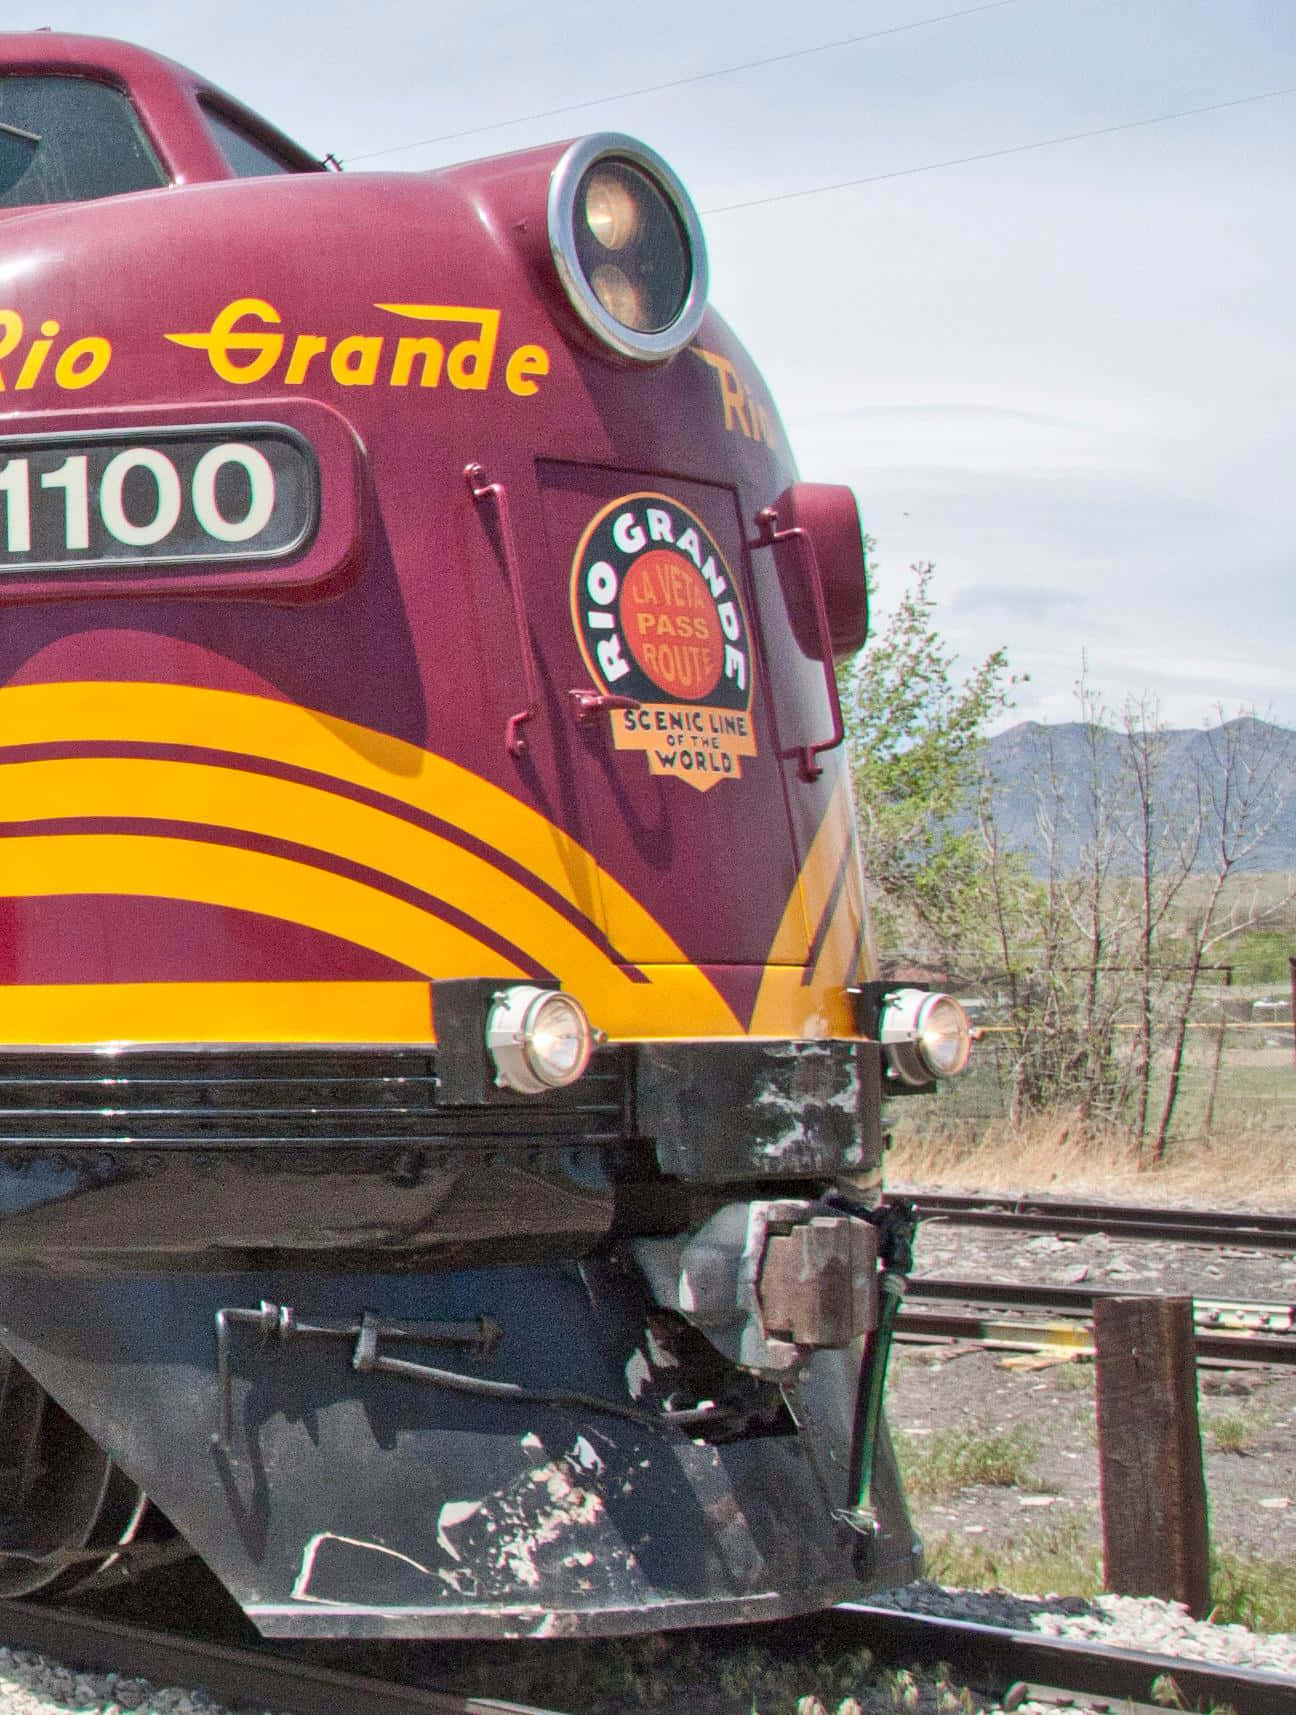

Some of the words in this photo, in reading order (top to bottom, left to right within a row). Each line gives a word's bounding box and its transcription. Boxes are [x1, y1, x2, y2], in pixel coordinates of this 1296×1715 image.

[163, 298, 550, 396] Grande
[588, 560, 631, 682] RIO
[613, 508, 748, 690] GRANDE
[633, 571, 657, 605] LA
[656, 563, 705, 609] VETA
[637, 612, 709, 639] PASS
[642, 643, 711, 687] ROUTE
[624, 699, 704, 732] SCENIC
[710, 713, 748, 736] LINE
[655, 750, 731, 773] WORLD
[667, 734, 684, 746] OF
[691, 735, 719, 749] THE
